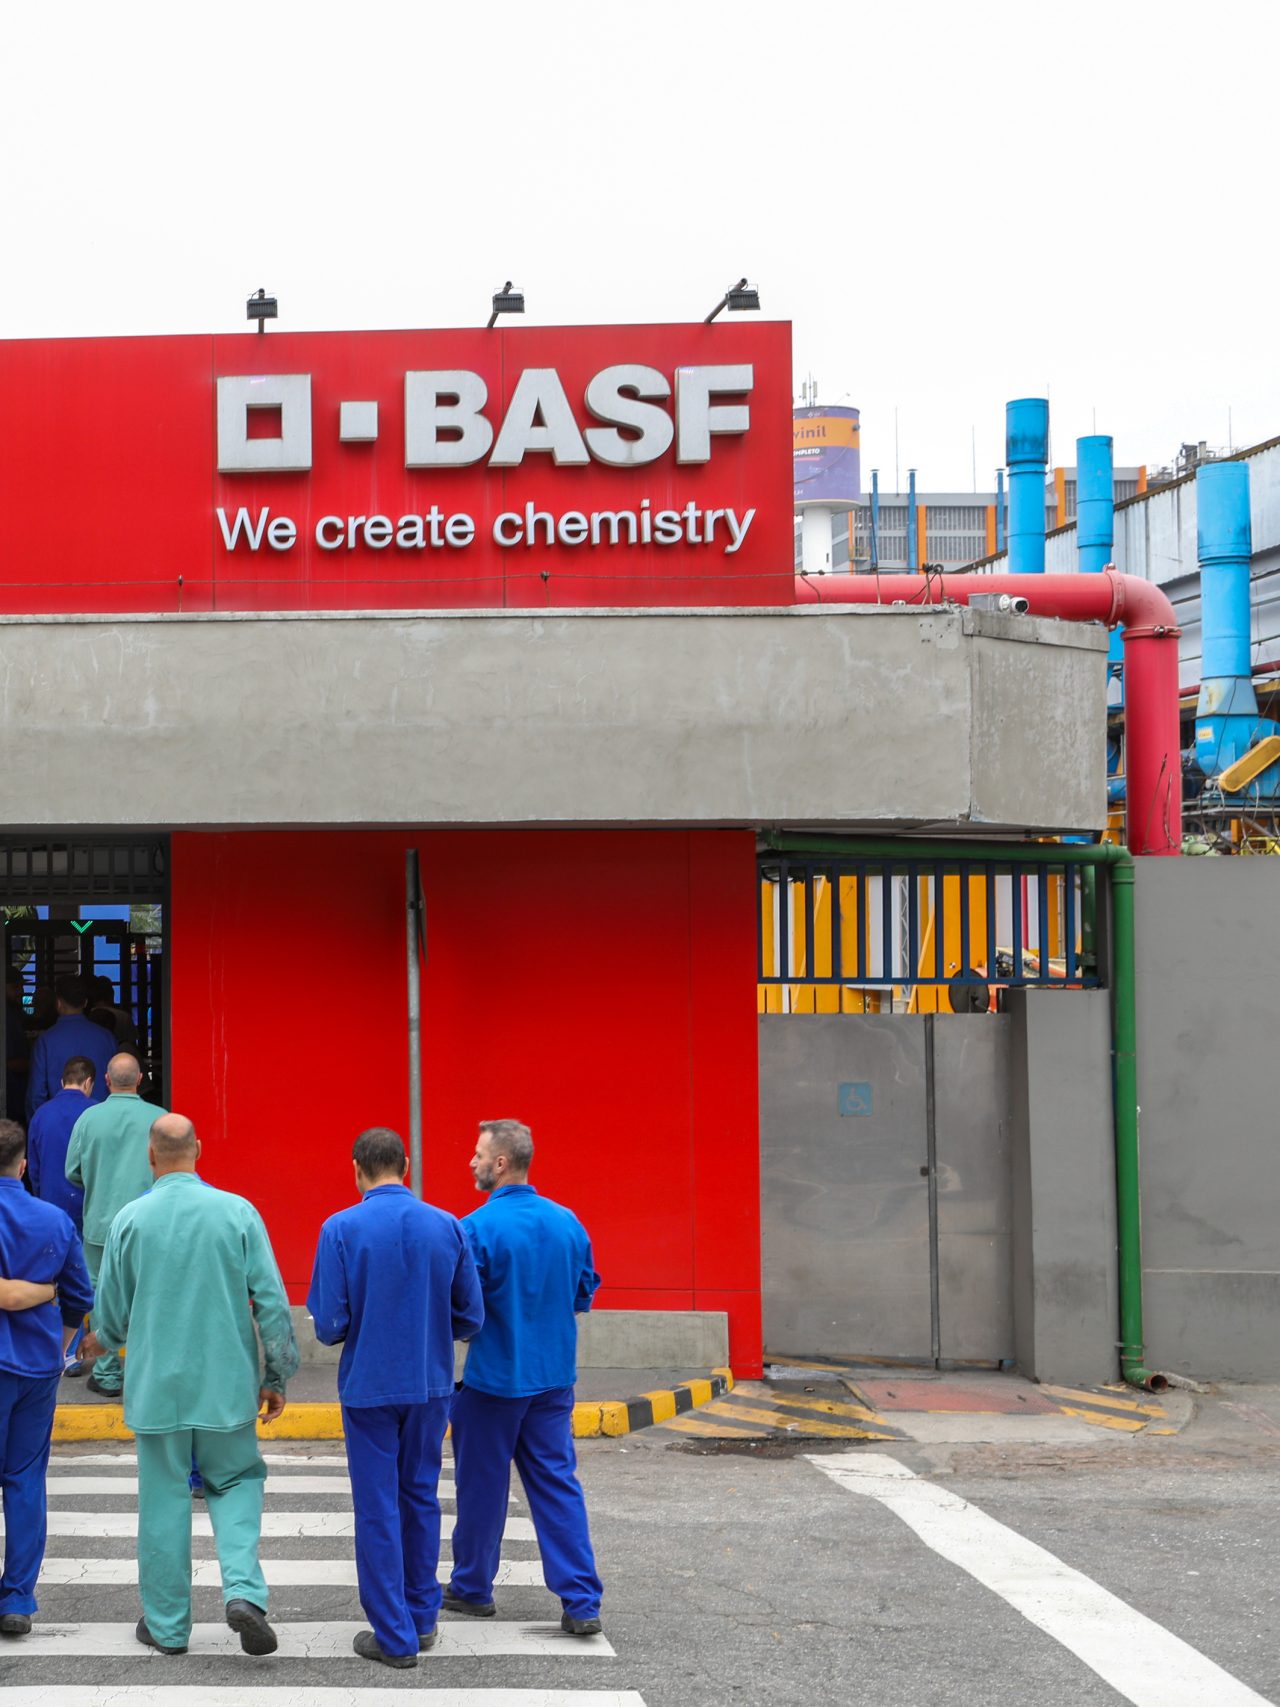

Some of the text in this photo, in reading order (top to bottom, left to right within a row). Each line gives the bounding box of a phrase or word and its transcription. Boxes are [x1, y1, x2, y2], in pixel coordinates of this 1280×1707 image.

[404, 363, 755, 469] BASF
[216, 499, 757, 554] We create chemistry
